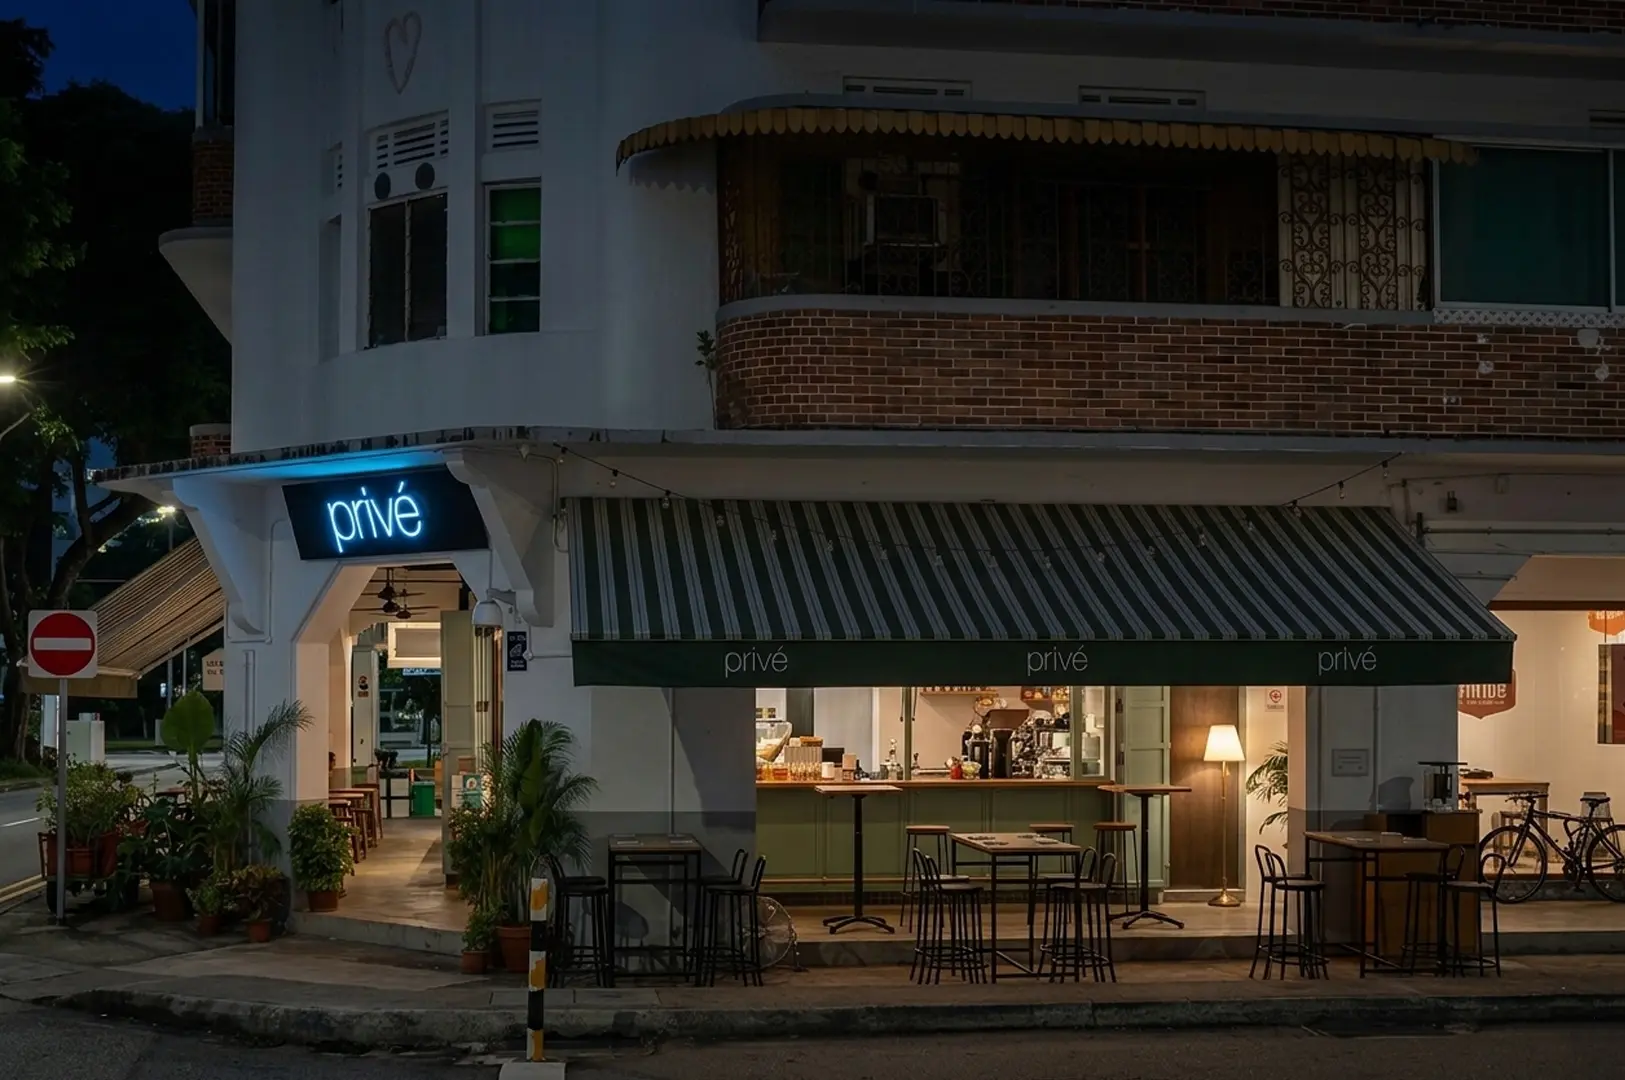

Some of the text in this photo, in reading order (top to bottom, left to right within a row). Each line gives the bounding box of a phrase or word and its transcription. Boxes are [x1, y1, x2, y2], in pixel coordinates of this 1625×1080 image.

[326, 480, 423, 554] privé
[724, 644, 789, 679] privé
[1027, 644, 1089, 677] privé
[1317, 645, 1377, 677] privé
